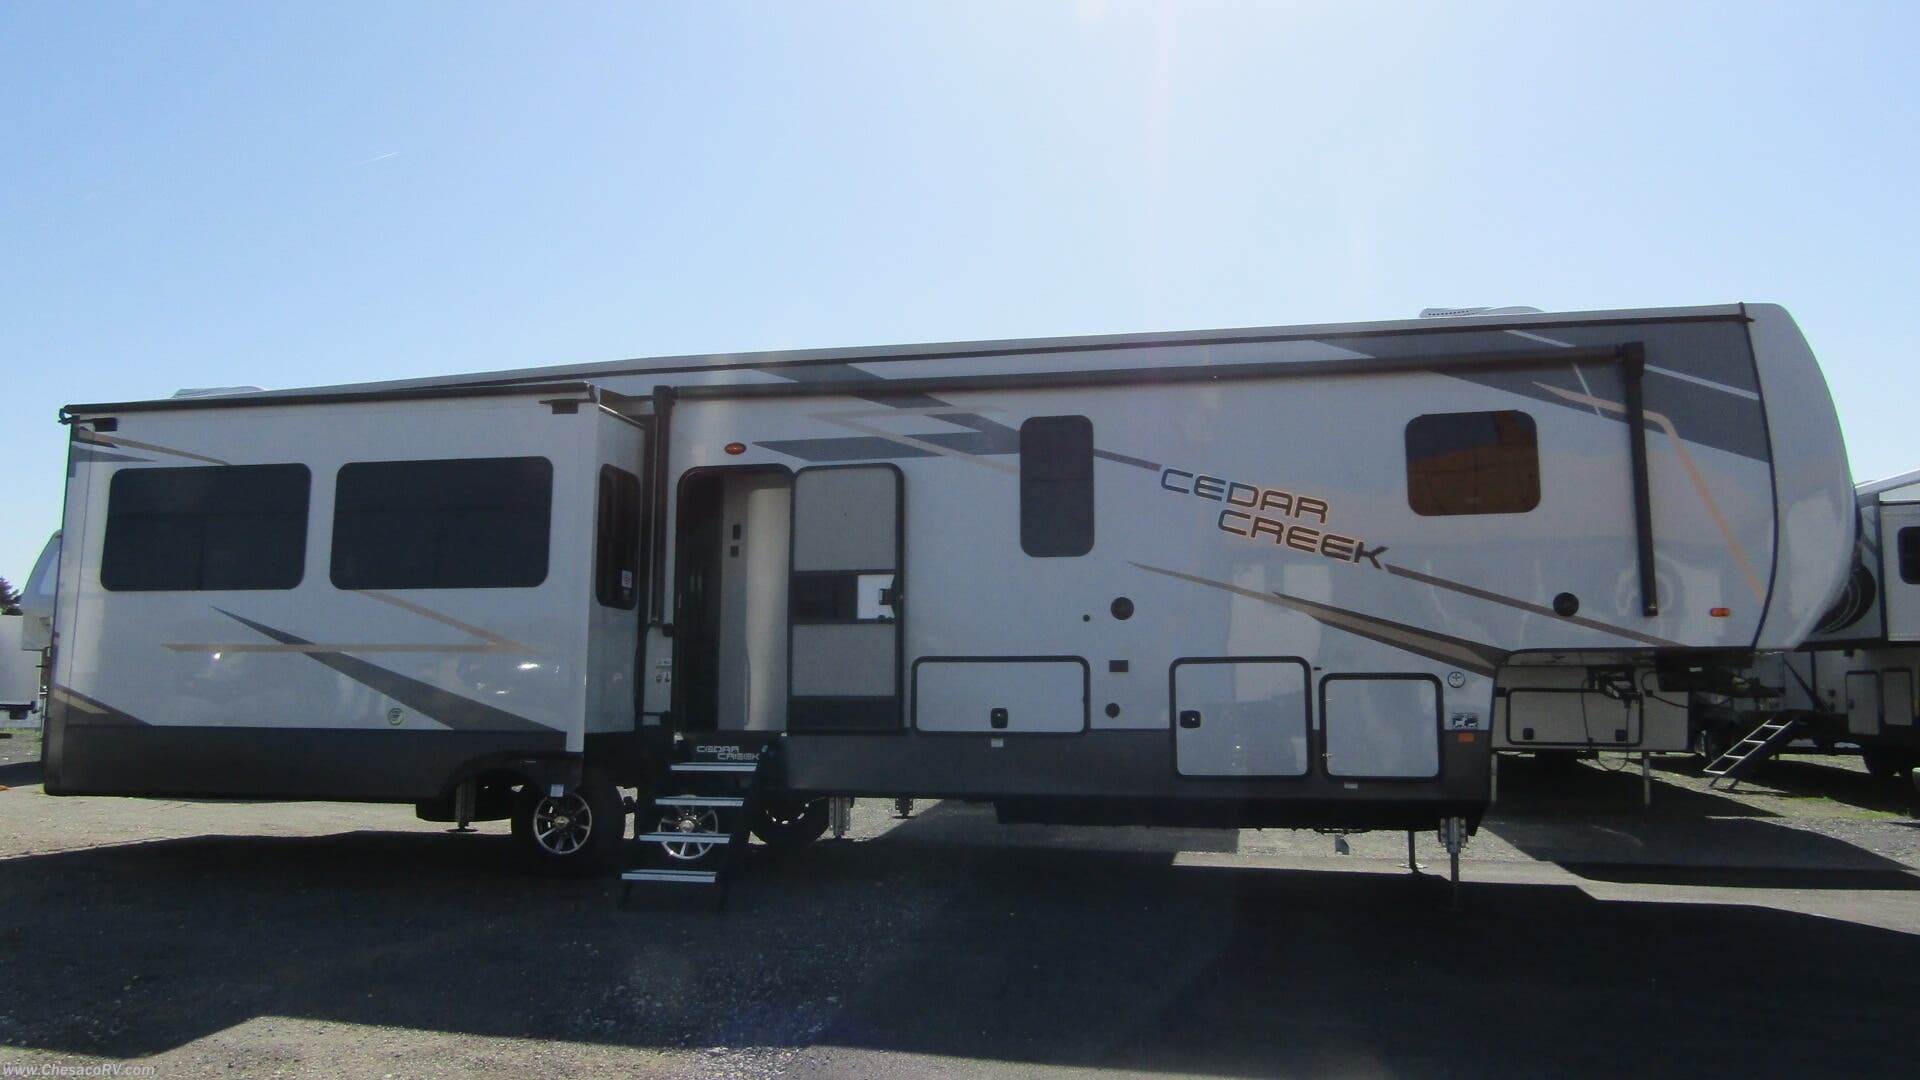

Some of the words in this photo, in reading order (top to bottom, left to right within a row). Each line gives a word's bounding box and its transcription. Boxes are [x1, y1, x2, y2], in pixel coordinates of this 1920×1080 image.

[1161, 467, 1329, 525] CEDAR
[1217, 509, 1390, 570] CREEK
[696, 745, 740, 753] CEDAR
[717, 752, 760, 760] CREEK
